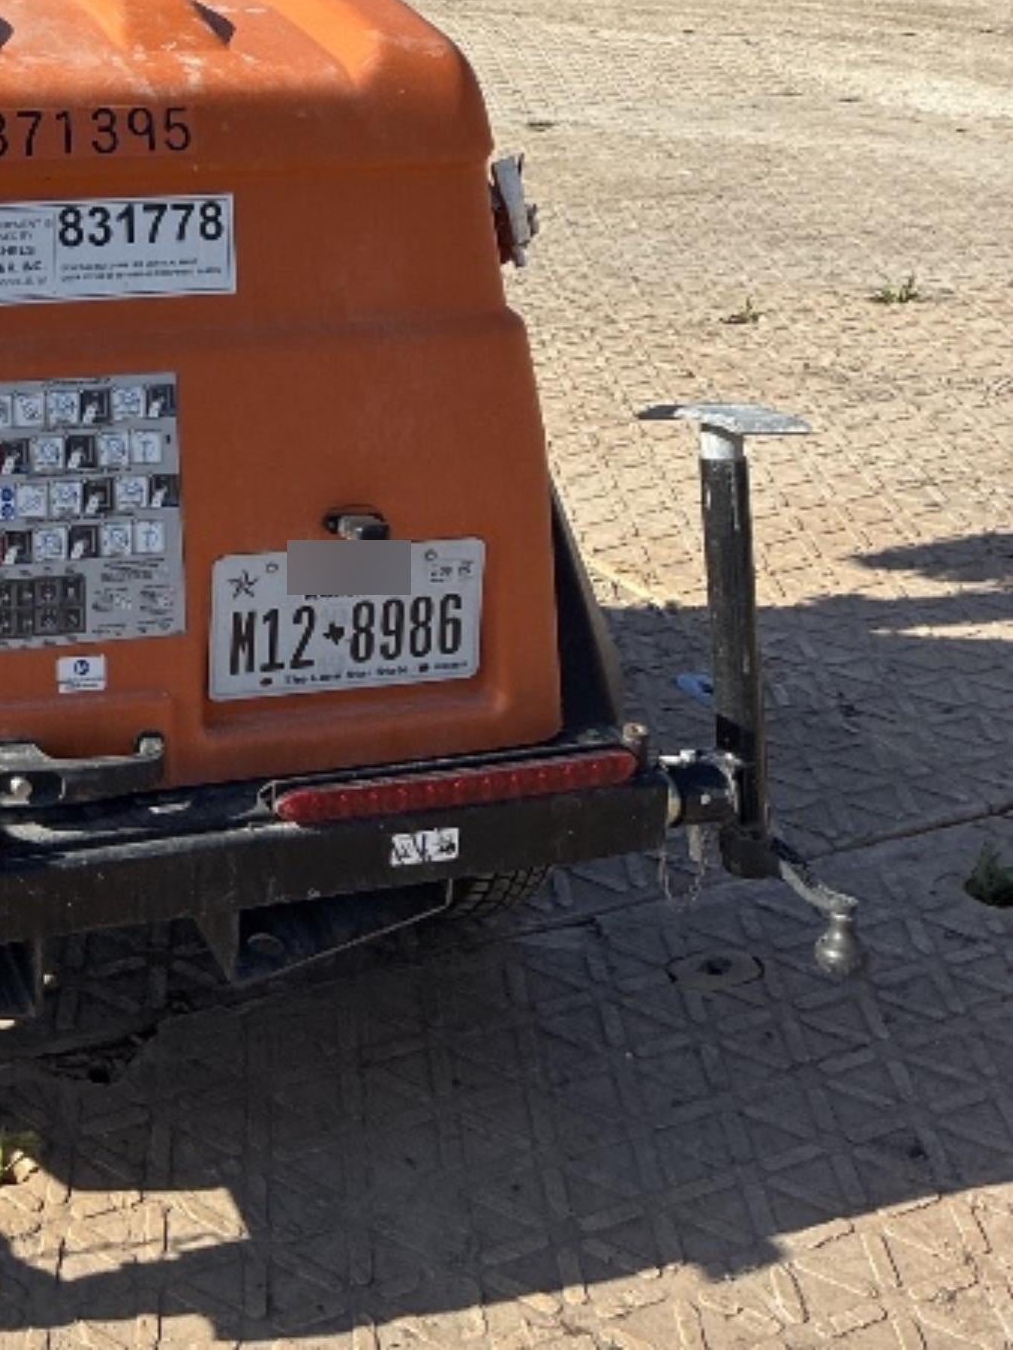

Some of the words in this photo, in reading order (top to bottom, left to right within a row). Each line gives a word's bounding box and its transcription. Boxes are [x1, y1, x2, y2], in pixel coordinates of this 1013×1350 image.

[58, 202, 224, 247] 831778
[229, 604, 316, 676] M12
[349, 593, 463, 663] 8986
